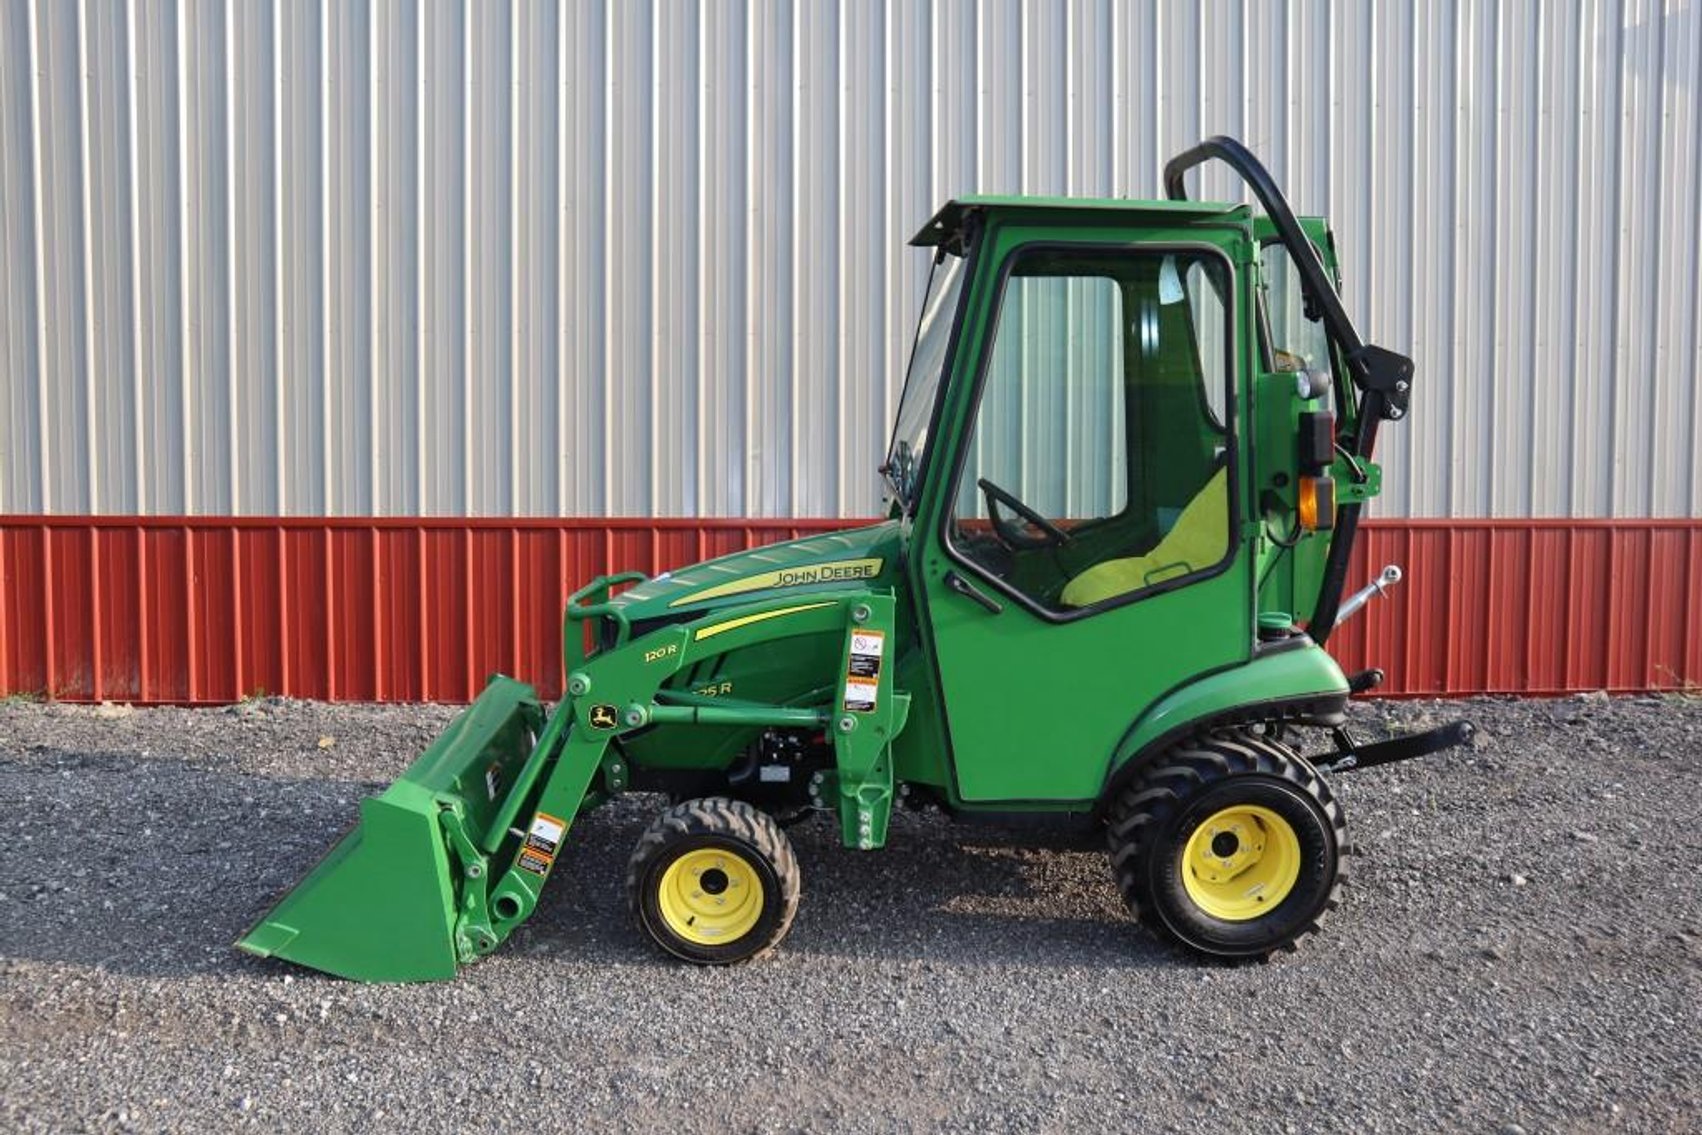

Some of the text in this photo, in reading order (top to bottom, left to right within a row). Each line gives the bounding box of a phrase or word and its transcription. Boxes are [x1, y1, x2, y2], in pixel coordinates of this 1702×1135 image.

[774, 565, 873, 586] JOHN DEERE
[645, 648, 666, 663] 120
[720, 682, 732, 694] R
